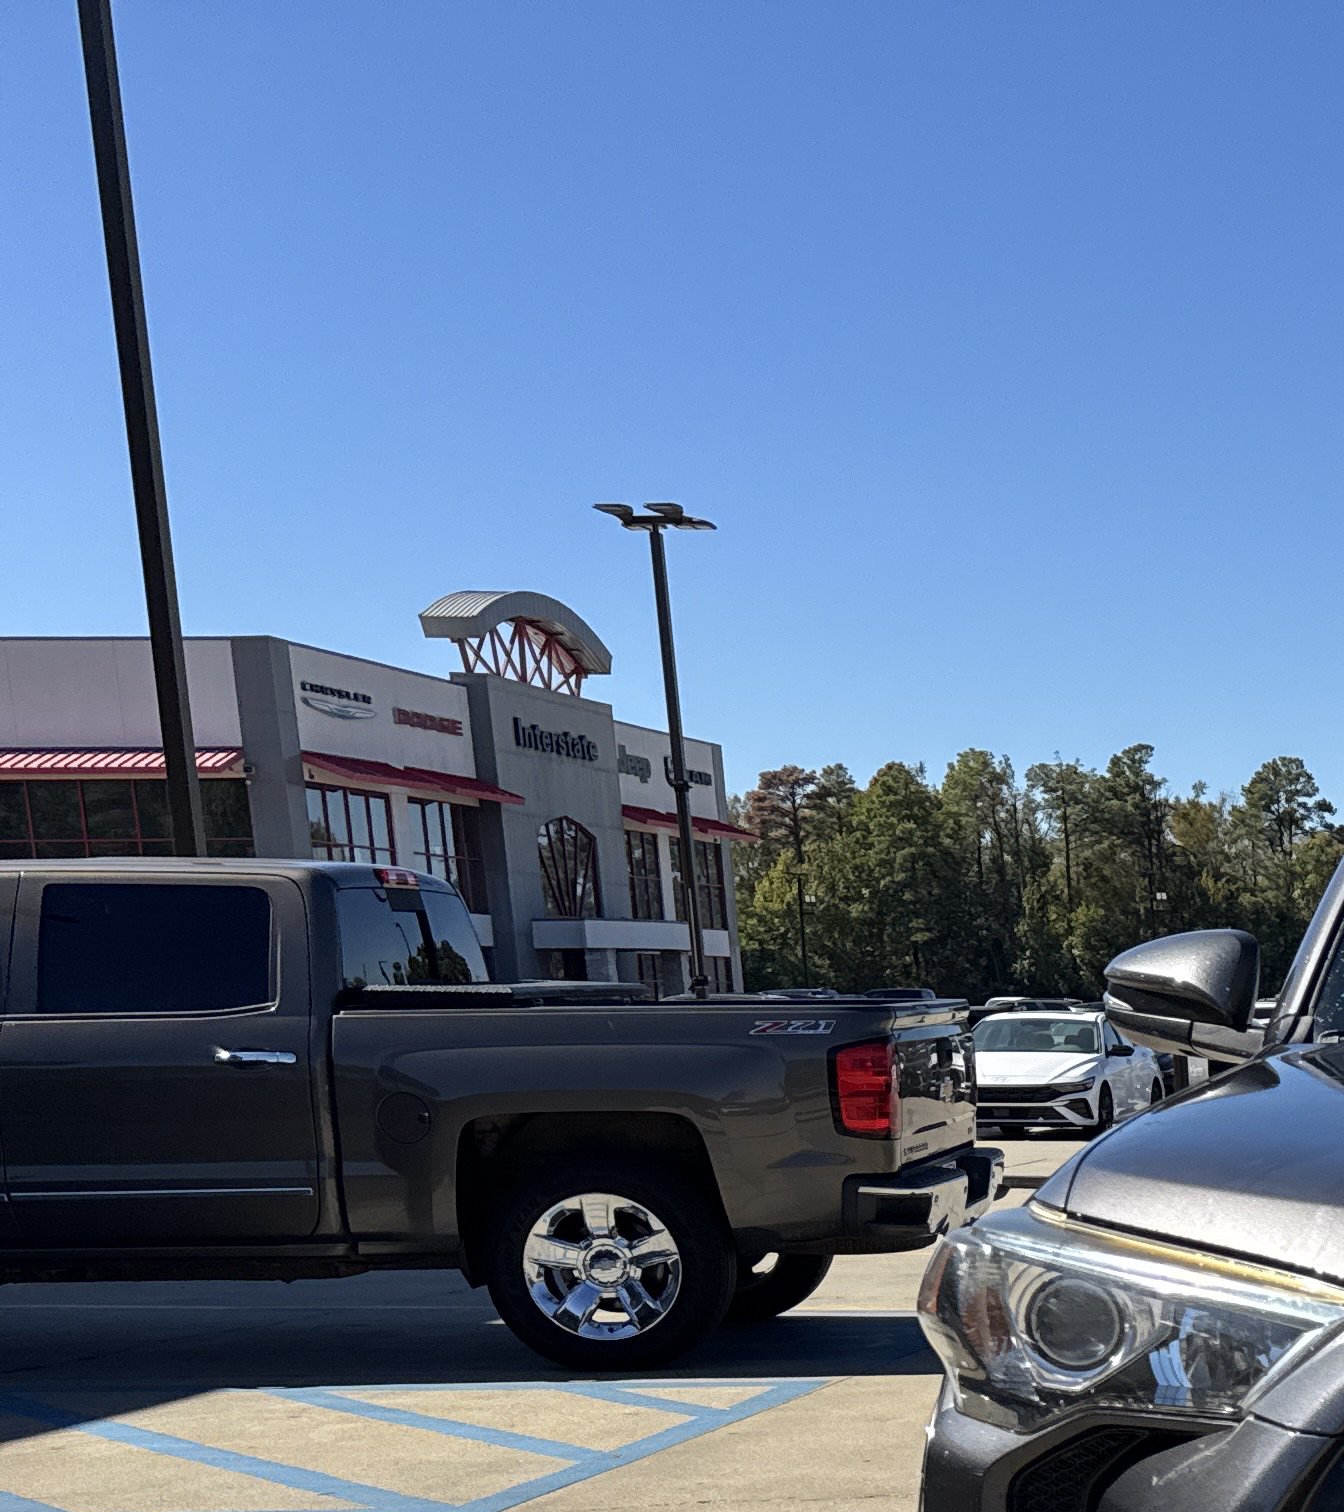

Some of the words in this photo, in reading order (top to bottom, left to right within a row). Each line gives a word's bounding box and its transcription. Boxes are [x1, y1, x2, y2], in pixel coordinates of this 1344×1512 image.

[392, 707, 463, 736] DODGE
[512, 716, 599, 761] Interstate
[748, 1019, 837, 1035] Z71
